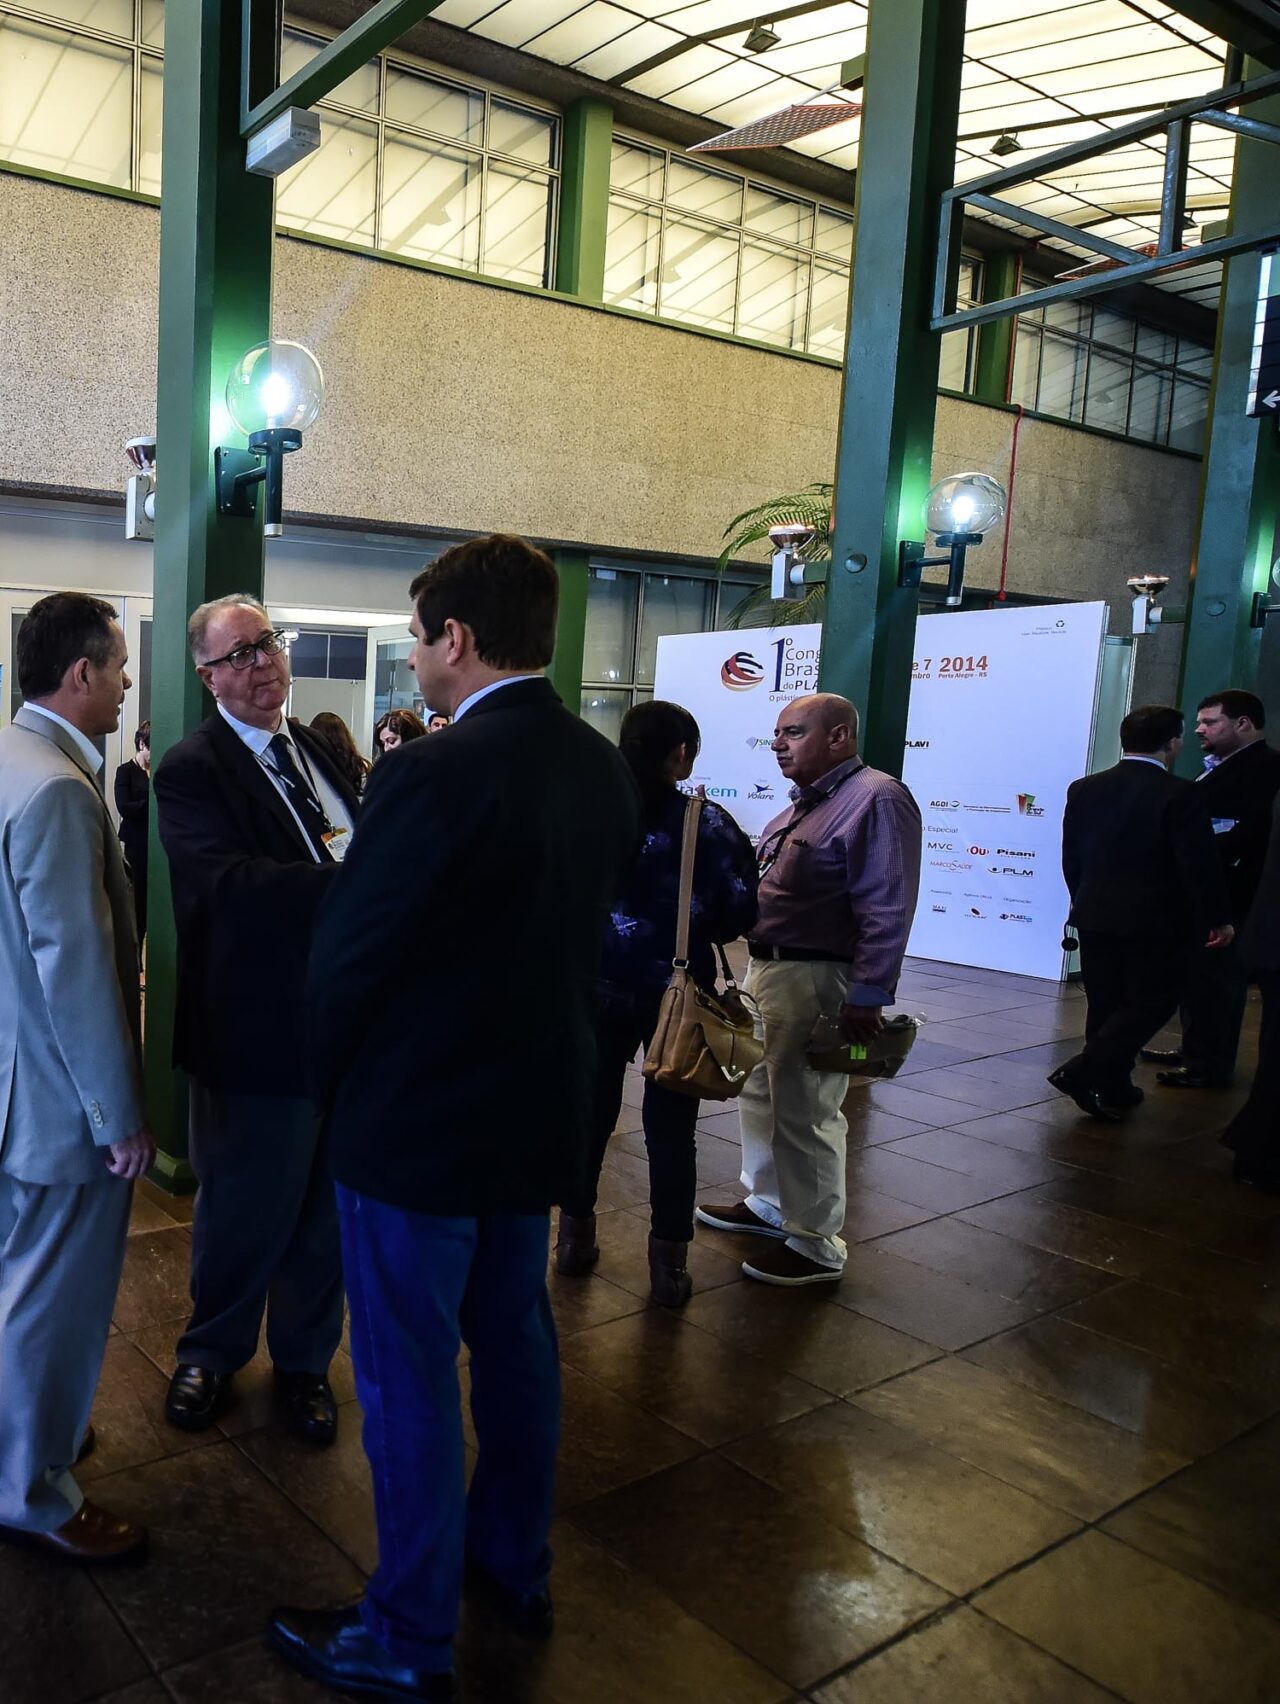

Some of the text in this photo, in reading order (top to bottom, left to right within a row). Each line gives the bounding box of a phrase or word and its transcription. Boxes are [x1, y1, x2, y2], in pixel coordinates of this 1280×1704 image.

[785, 647, 821, 663] Cong
[923, 658, 932, 671] 7
[939, 655, 989, 672] 2014
[784, 662, 820, 677] Bras
[954, 671, 974, 679] Alegre
[783, 682, 794, 690] do
[747, 792, 775, 800] Volare
[927, 825, 958, 833] Especial
[927, 842, 953, 851] MVC
[996, 848, 1036, 858] Pisani
[1002, 867, 1034, 877] PLM
